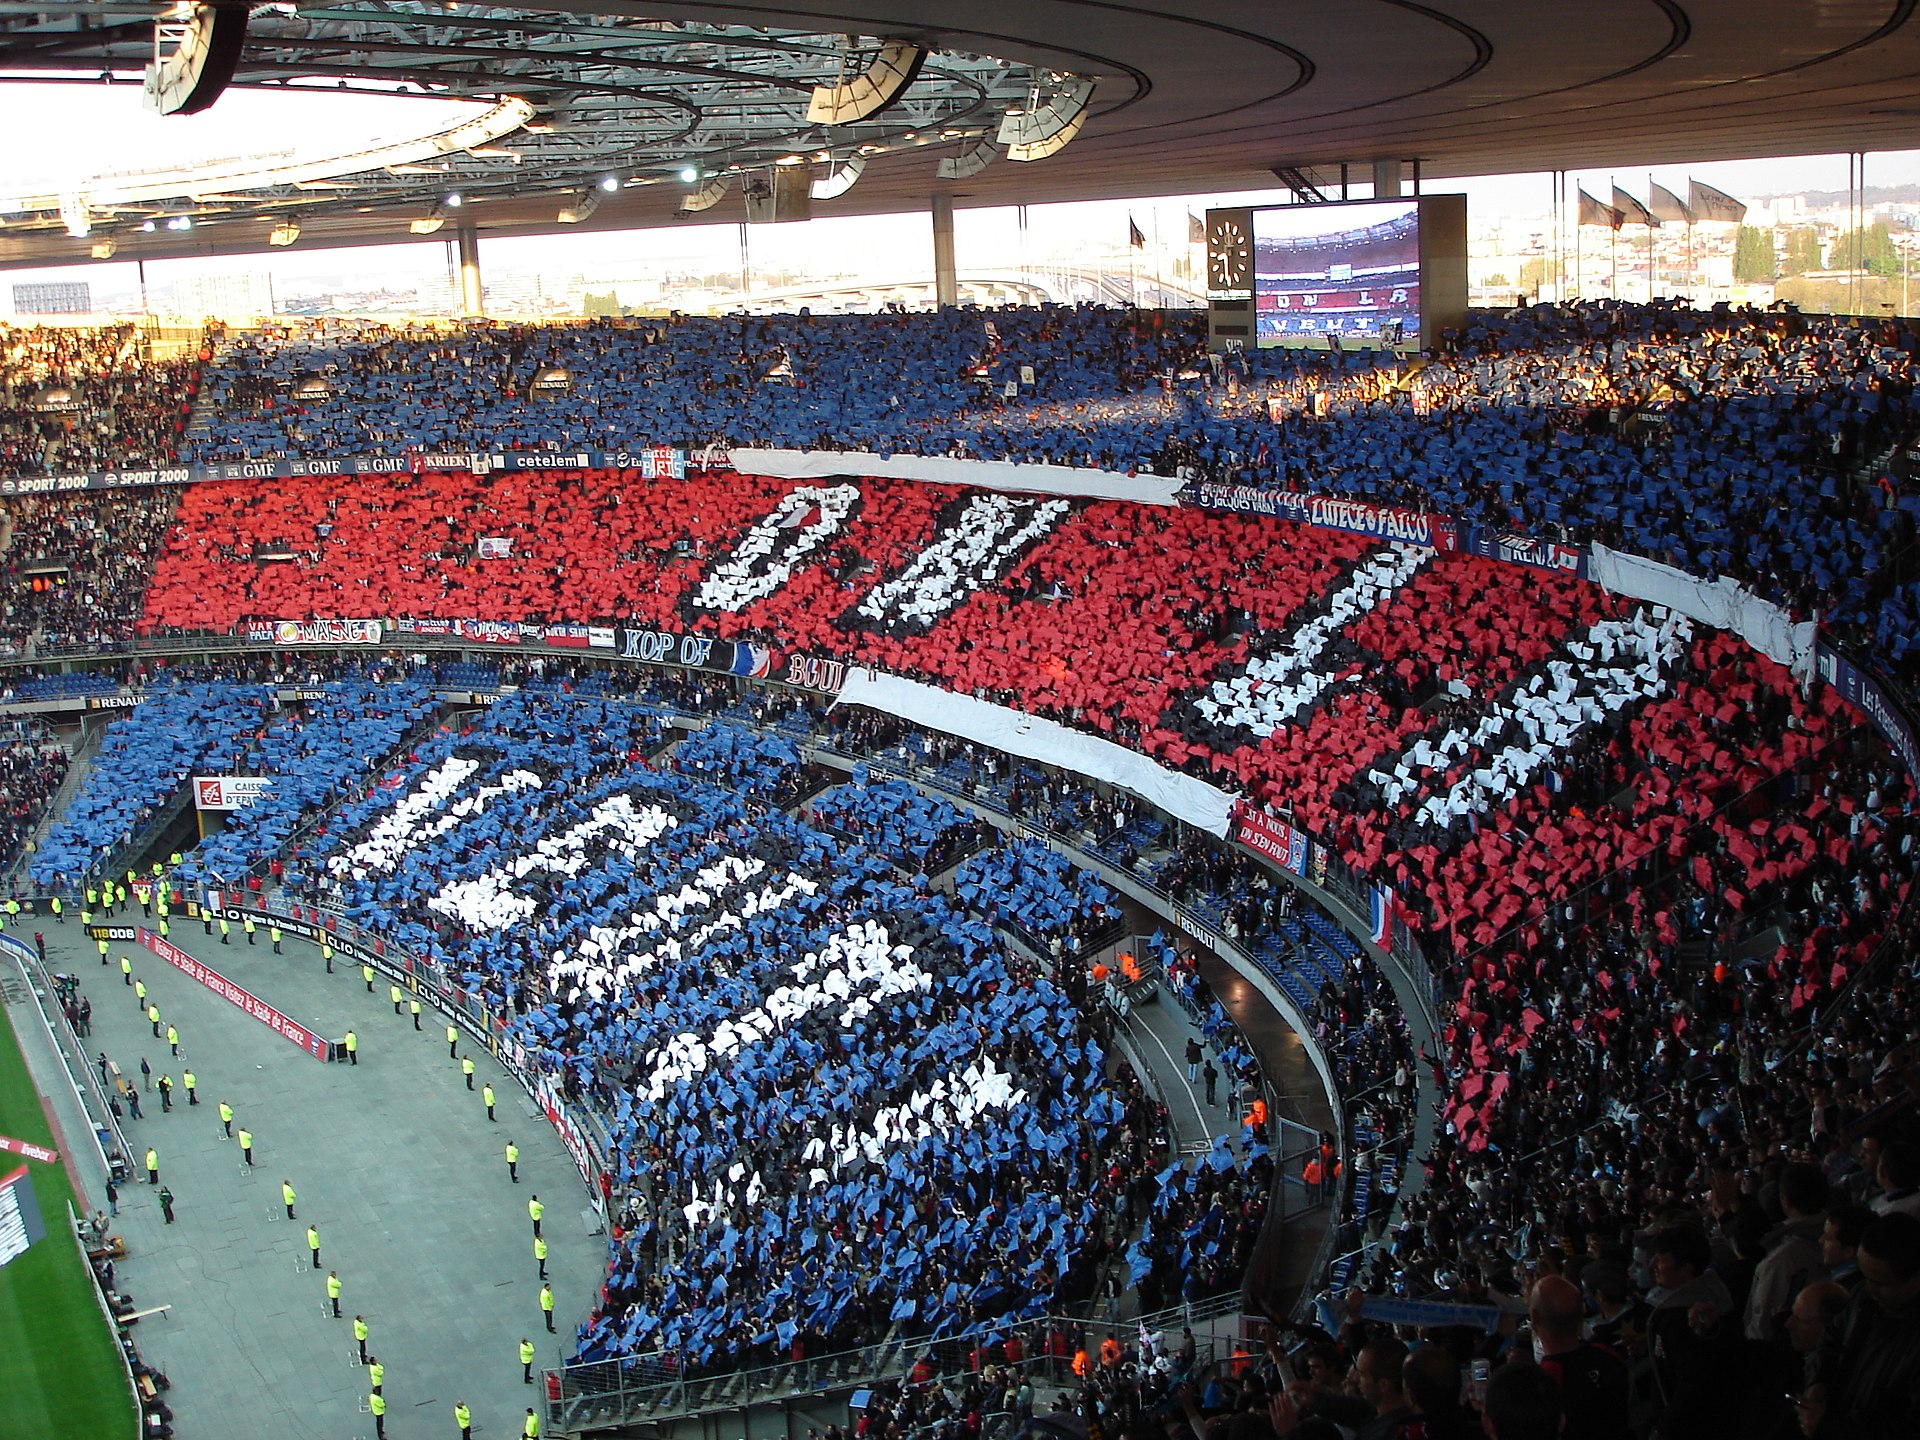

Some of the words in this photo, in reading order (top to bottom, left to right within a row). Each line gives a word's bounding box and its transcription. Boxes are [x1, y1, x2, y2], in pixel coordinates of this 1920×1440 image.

[43, 402, 79, 412] RENAULT
[308, 460, 341, 474] GMF
[372, 458, 405, 472] GMF
[517, 454, 577, 468] cetelem
[120, 473, 157, 485] SPORT
[159, 469, 189, 483] 2000
[243, 463, 276, 478] GMF
[18, 479, 56, 492] SPORT
[58, 476, 89, 489] 2000
[248, 621, 273, 631] VAR
[620, 628, 675, 663] KOP
[680, 636, 712, 667] OF
[92, 927, 135, 940] 118008
[1180, 917, 1215, 950] RENAULT
[327, 936, 354, 955] CLIO
[154, 938, 173, 962] Visitez
[180, 953, 196, 977] Stade
[196, 965, 205, 982] de
[205, 970, 224, 995] France
[225, 982, 245, 1008] Visitez
[252, 1000, 271, 1024] Stade
[271, 1012, 281, 1031] de
[282, 1018, 304, 1046] France
[418, 984, 440, 1007] CLIO
[498, 1048, 518, 1075] CLIO
